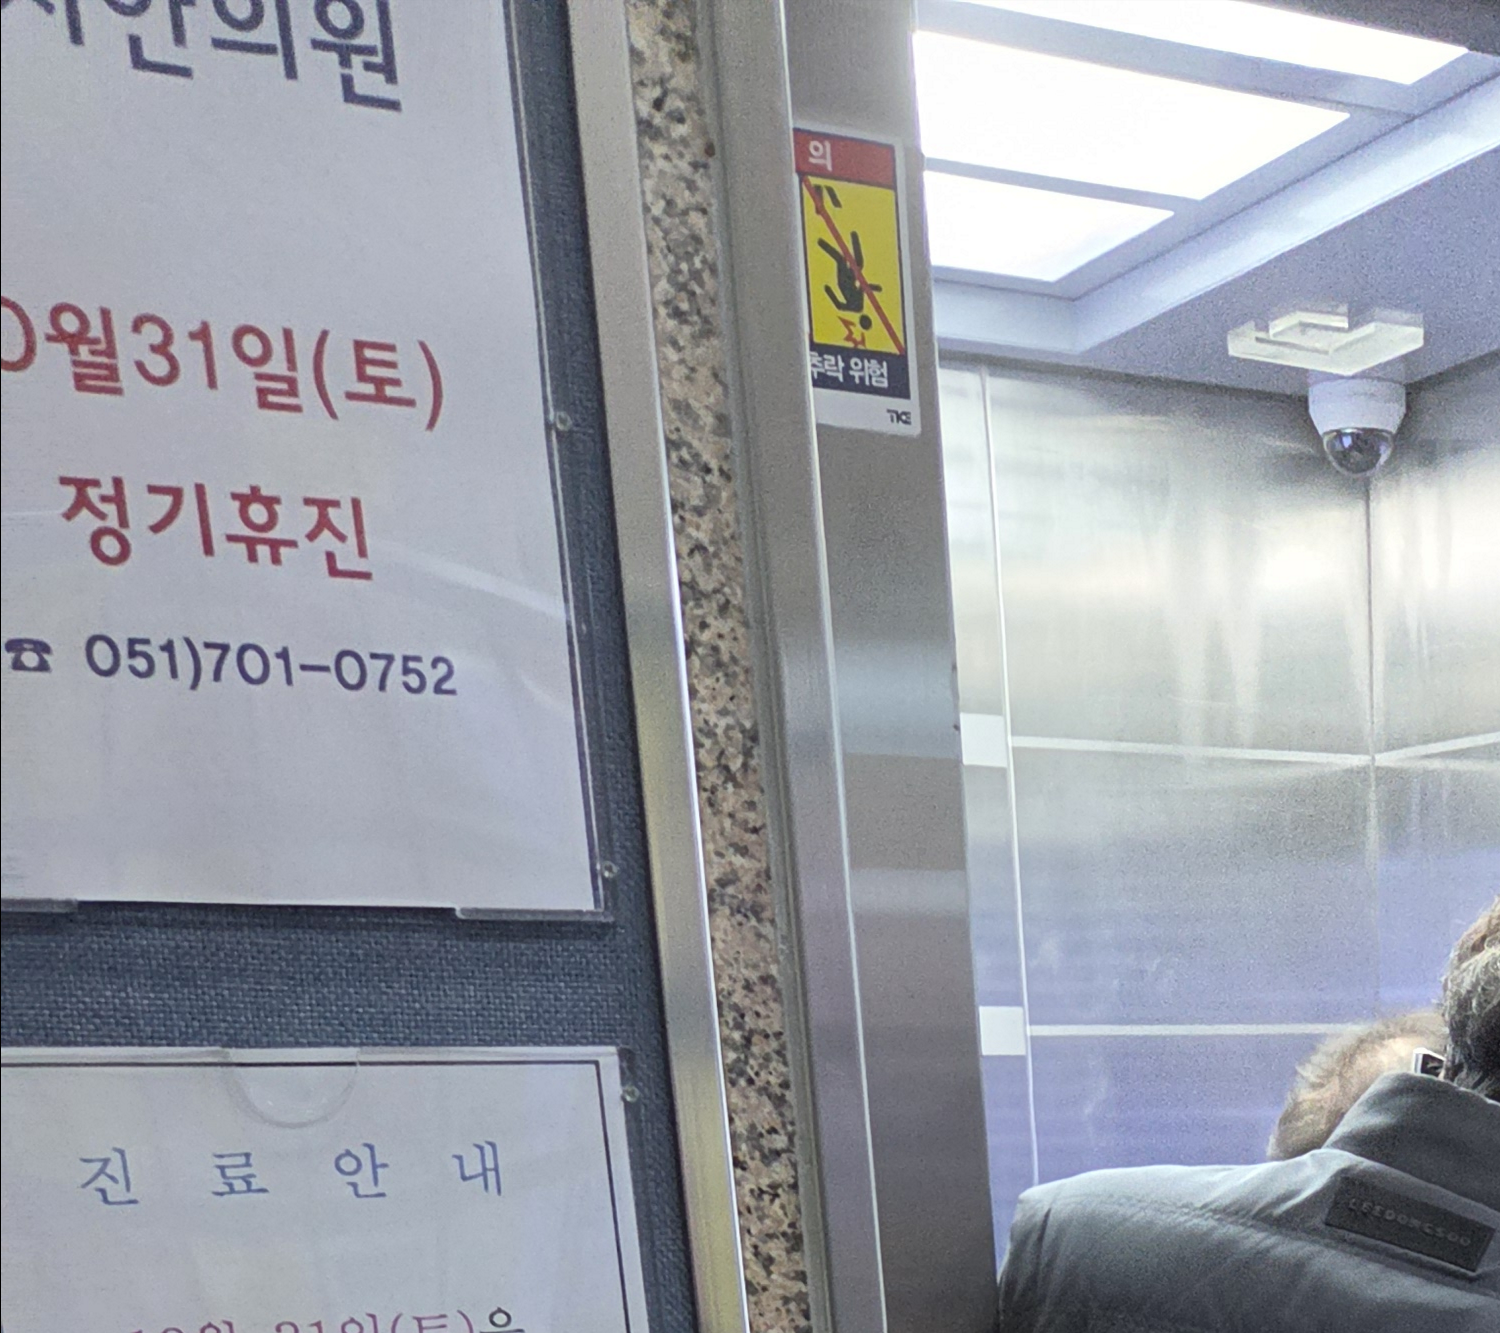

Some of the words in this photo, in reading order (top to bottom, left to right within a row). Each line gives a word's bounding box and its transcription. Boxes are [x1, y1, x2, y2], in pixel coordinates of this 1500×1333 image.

[0, 0, 402, 113] 안의원
[810, 351, 845, 383] 추락
[849, 357, 889, 389] 위험
[58, 475, 373, 581] 정기휴진
[85, 634, 458, 696] 051)701-0752
